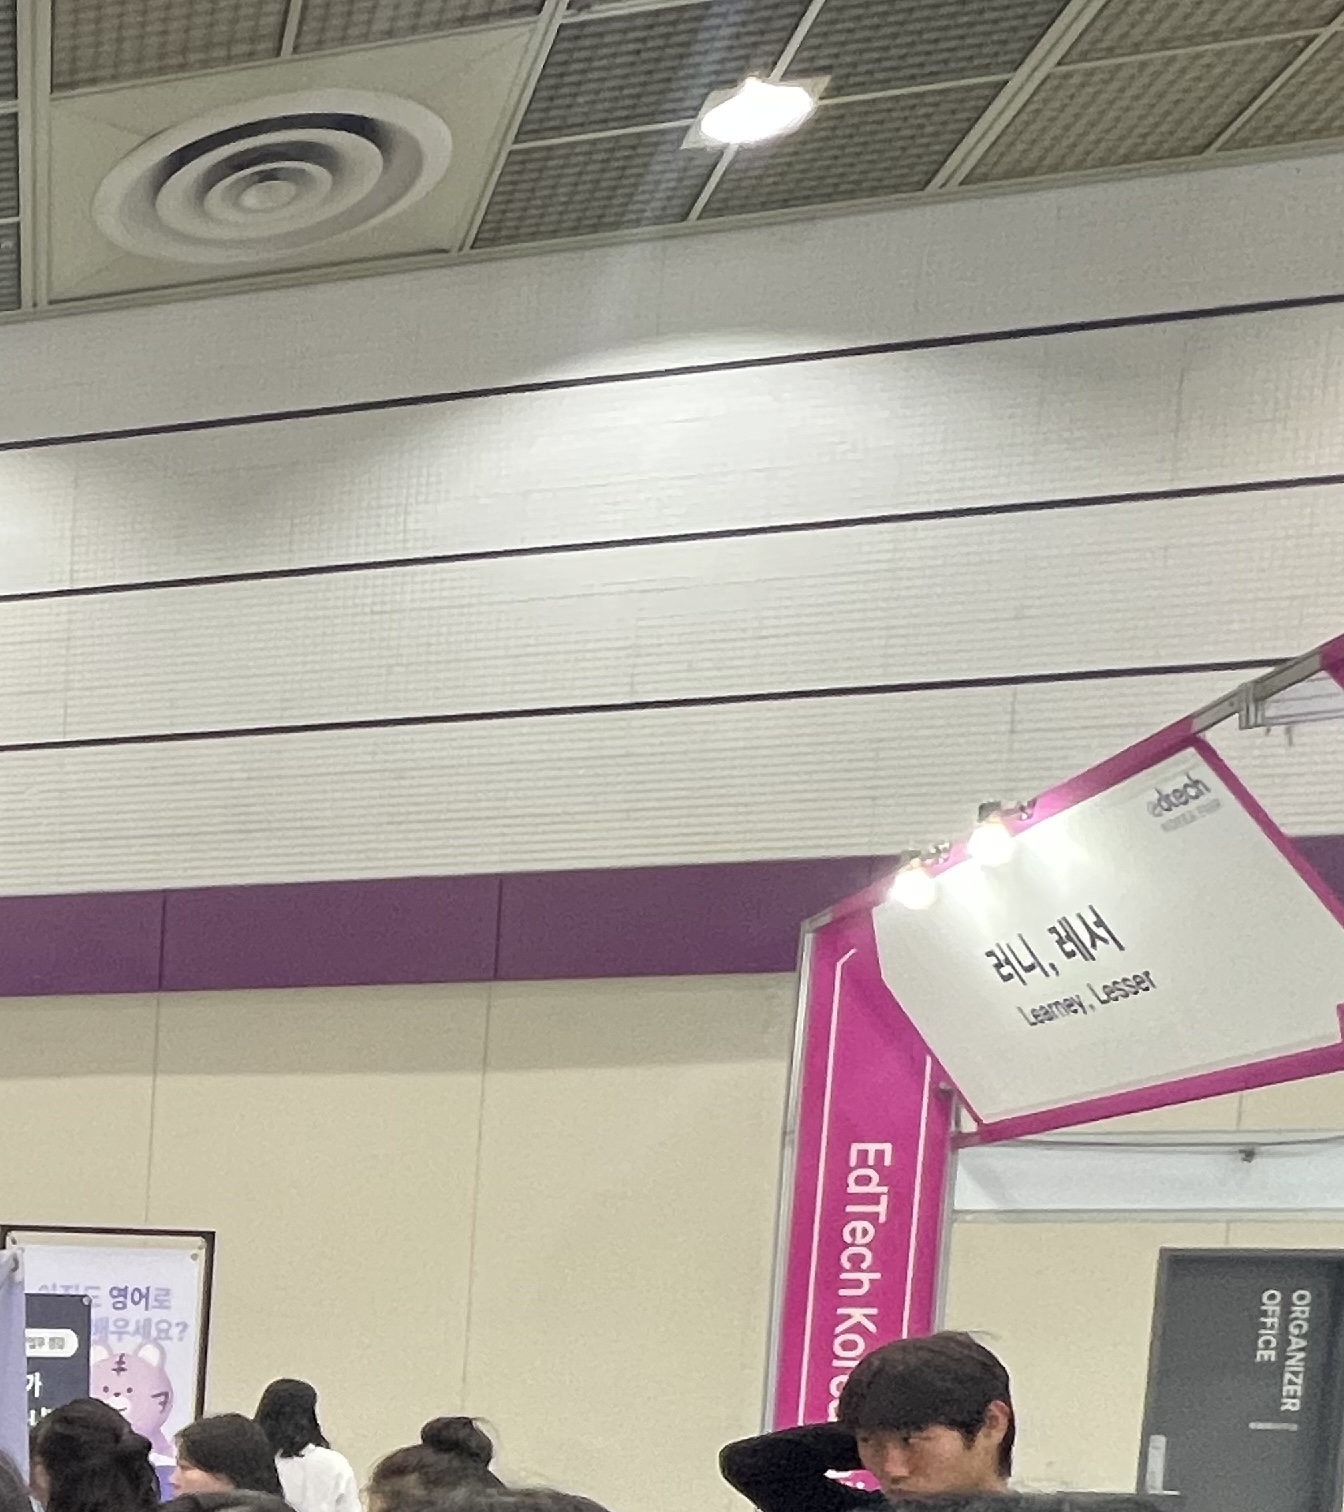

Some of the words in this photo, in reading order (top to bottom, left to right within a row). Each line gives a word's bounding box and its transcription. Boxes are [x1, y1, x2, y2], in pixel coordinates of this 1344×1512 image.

[1146, 772, 1212, 818] edtech
[984, 932, 1060, 987] 러니,
[1047, 904, 1125, 961] 레서
[1086, 970, 1158, 1005] Lesser
[838, 1142, 893, 1296] EdTech
[108, 1285, 172, 1311] 영어로
[1255, 1289, 1281, 1363] OFFICE
[1280, 1290, 1312, 1412] ORGANIZER
